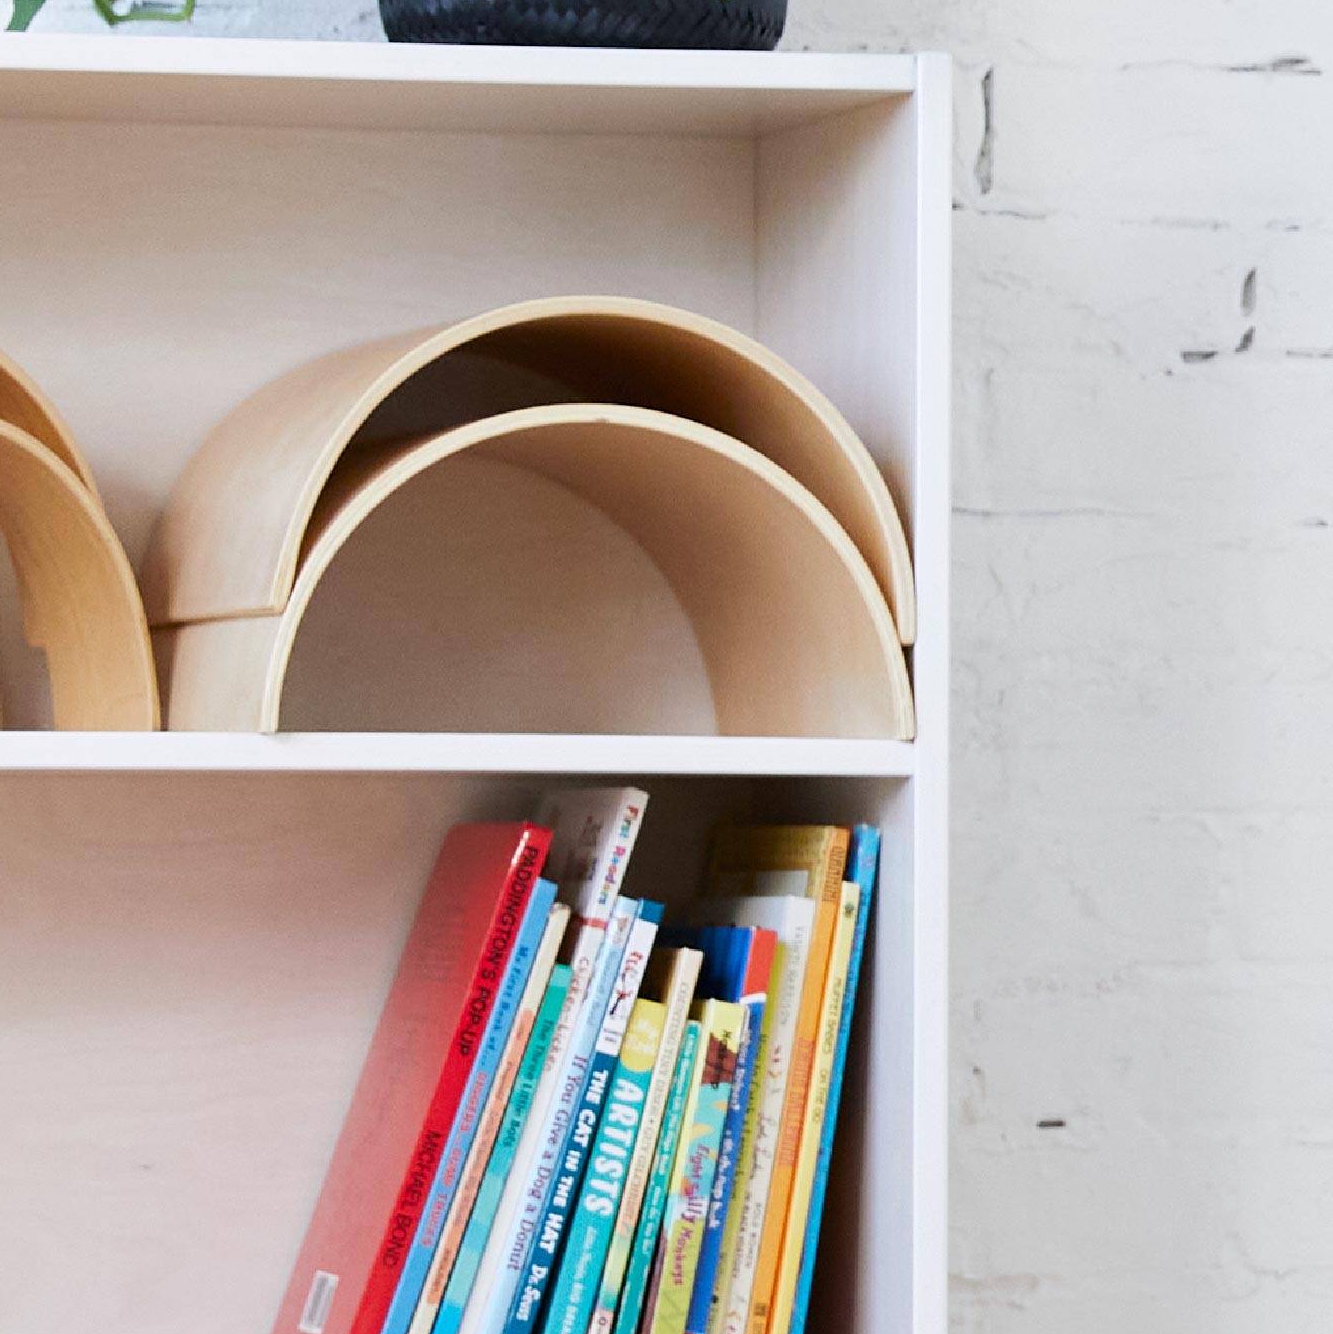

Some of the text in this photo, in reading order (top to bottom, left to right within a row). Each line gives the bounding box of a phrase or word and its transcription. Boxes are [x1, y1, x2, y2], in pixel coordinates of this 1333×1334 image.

[597, 804, 639, 905] First Readers
[480, 845, 539, 982] PADDINGTON'S
[454, 985, 491, 1057] POP-UP
[537, 1019, 554, 1042] The
[524, 1044, 546, 1081] Three
[570, 1054, 587, 1070] If
[559, 1073, 581, 1104] You
[545, 1107, 570, 1147] Give
[580, 1077, 647, 1217] ARTISTS
[528, 1164, 552, 1200] Dog
[537, 1067, 609, 1254] THE CAT IN THE HAT
[688, 1143, 710, 1181] Eight
[381, 1129, 440, 1270] MICHAEL BOND
[505, 1218, 535, 1272] Donut
[666, 1226, 696, 1286] Monkeys
[514, 1285, 540, 1322] Seuss
